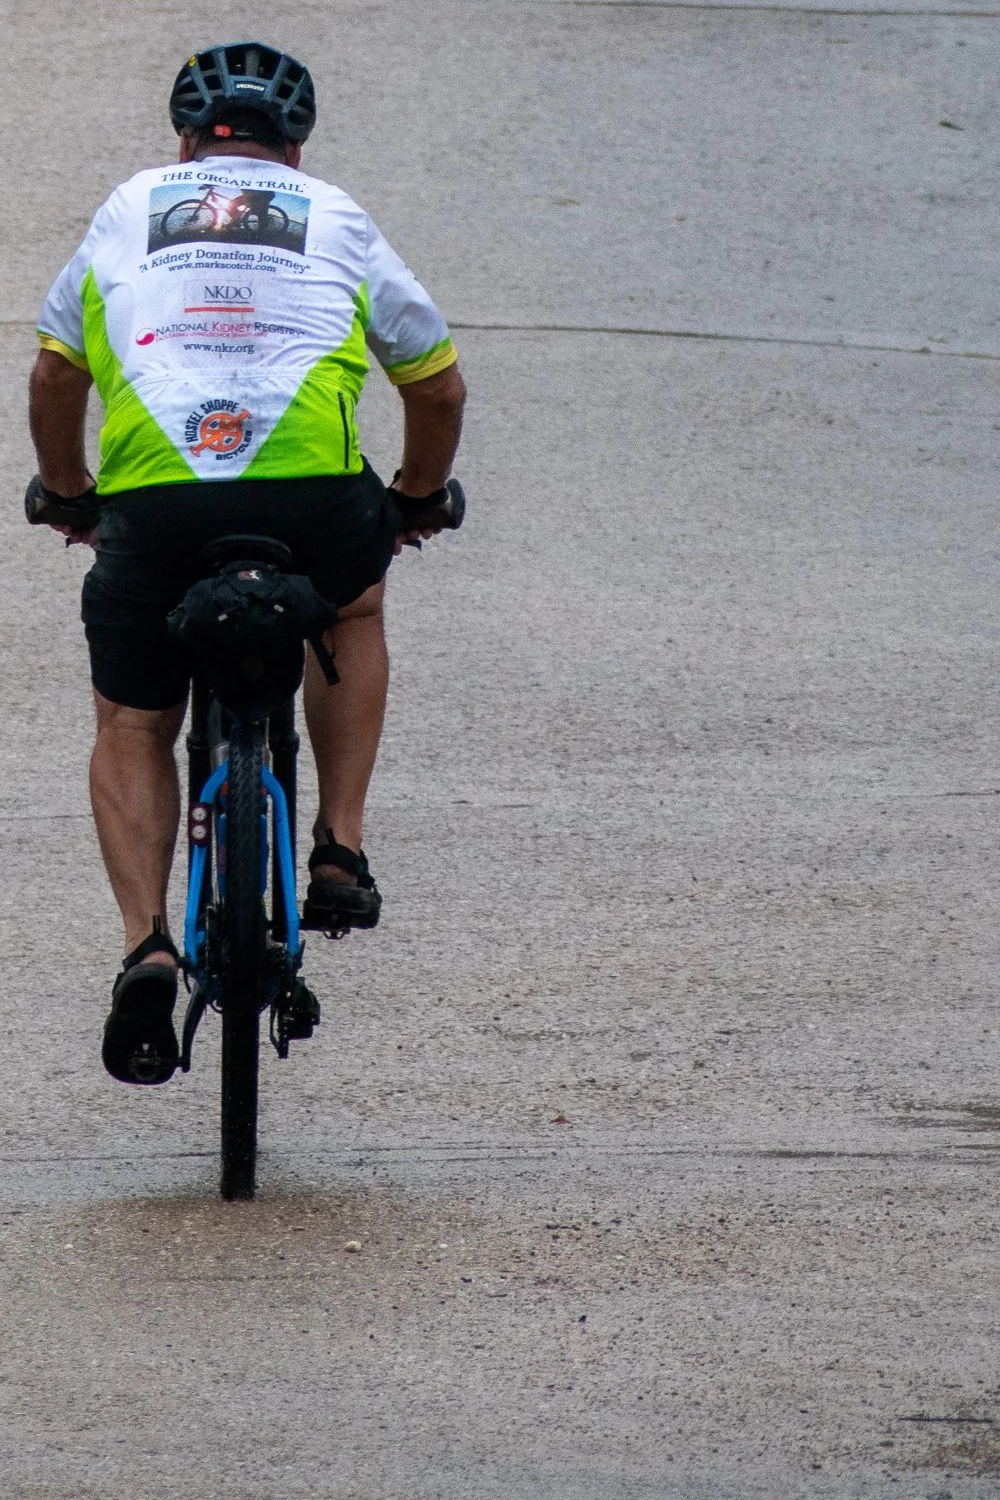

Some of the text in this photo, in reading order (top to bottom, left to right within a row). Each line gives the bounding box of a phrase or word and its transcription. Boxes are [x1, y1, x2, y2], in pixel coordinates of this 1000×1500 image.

[161, 171, 304, 193] THE ORGAN TRAIL
[151, 252, 193, 268] Kidney
[195, 249, 255, 261] Donation
[168, 261, 276, 273] www.markscotch.com
[204, 285, 252, 300] NKDO
[156, 322, 209, 336] NATIONAL
[212, 321, 251, 332] KIDNEY
[183, 343, 255, 354] www.nkr.org
[185, 399, 240, 443] HOSTEL SHOPPE
[215, 430, 253, 460] BICYCLES
